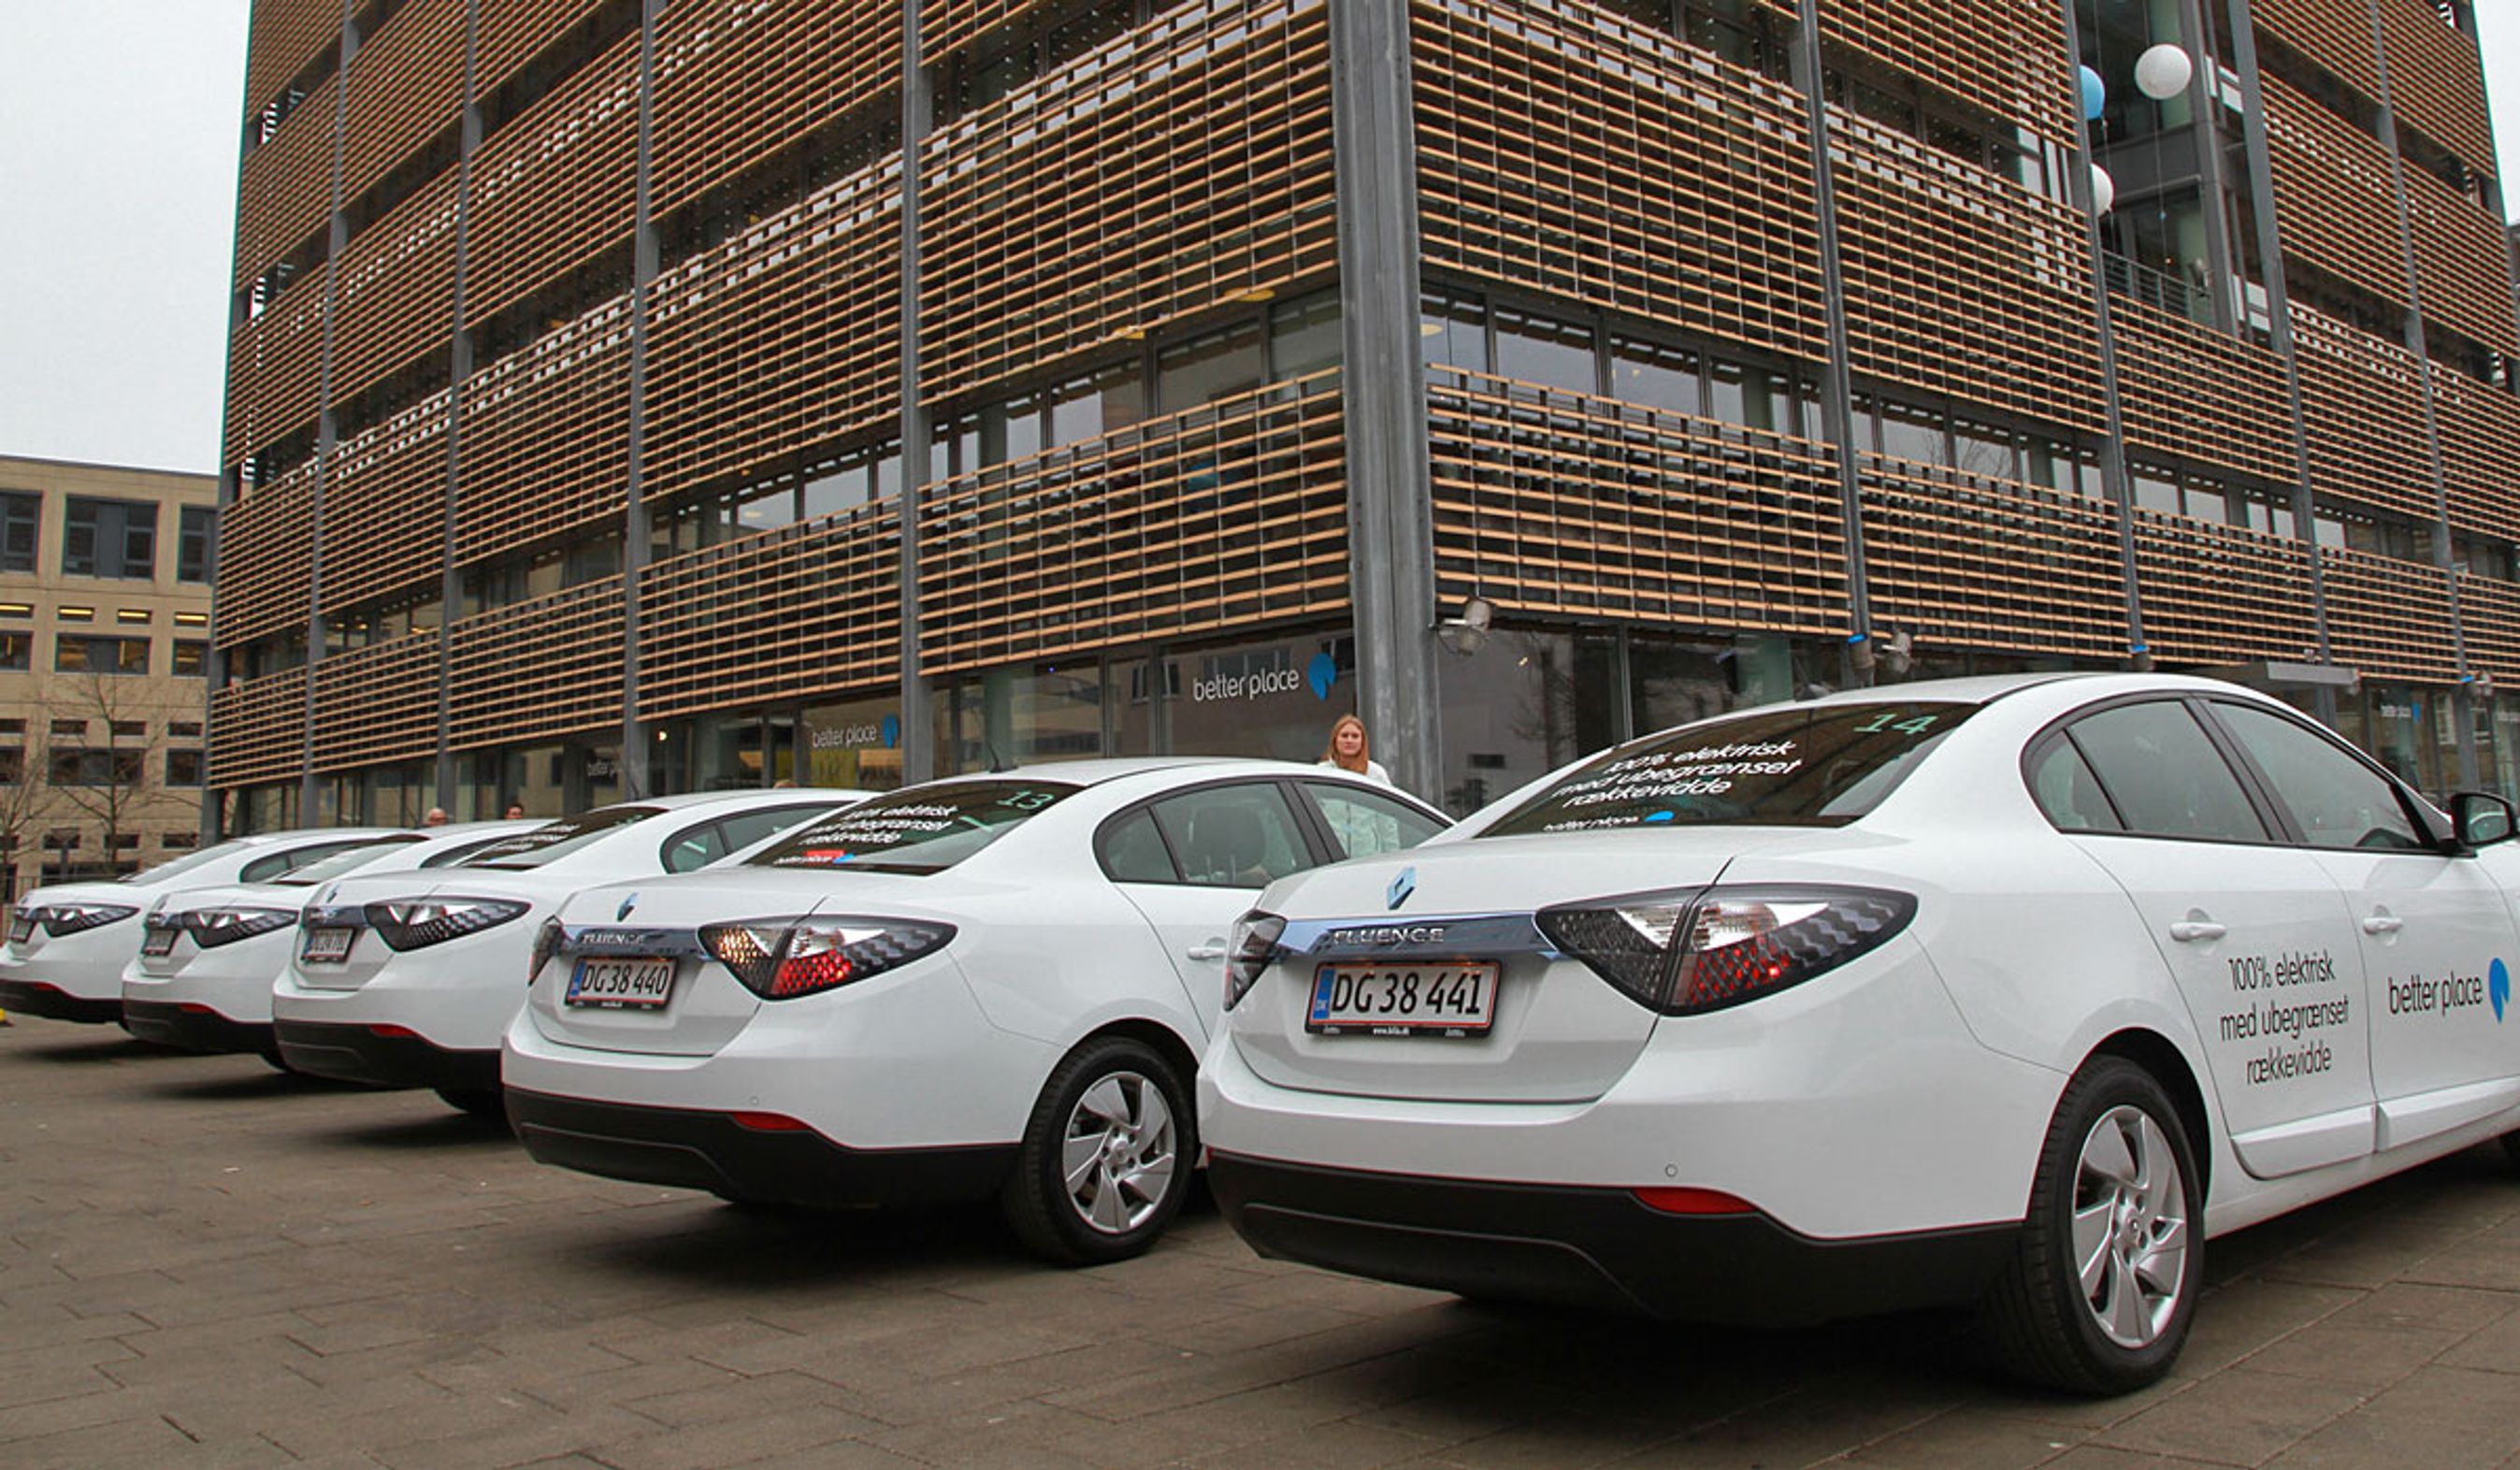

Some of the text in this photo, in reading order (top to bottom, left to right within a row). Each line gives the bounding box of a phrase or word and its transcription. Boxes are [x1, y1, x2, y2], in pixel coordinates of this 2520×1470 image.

[1192, 668, 1300, 701] better place
[812, 724, 877, 748] better place
[1854, 713, 1938, 736] 14
[1673, 740, 1797, 765] elektrisk
[1616, 758, 1803, 785] ubegrænset
[995, 789, 1055, 811] 13
[1562, 777, 1733, 808] rækkevidde
[1333, 927, 1446, 945] FLUENCE
[581, 963, 670, 995] DG 38 440
[2227, 948, 2337, 991] 100% elektrisk
[1331, 972, 1482, 1016] DG 38 441
[2387, 970, 2484, 1017] better place
[2219, 994, 2350, 1042] med ubegrænset
[2246, 1038, 2333, 1086] rækkevidde
